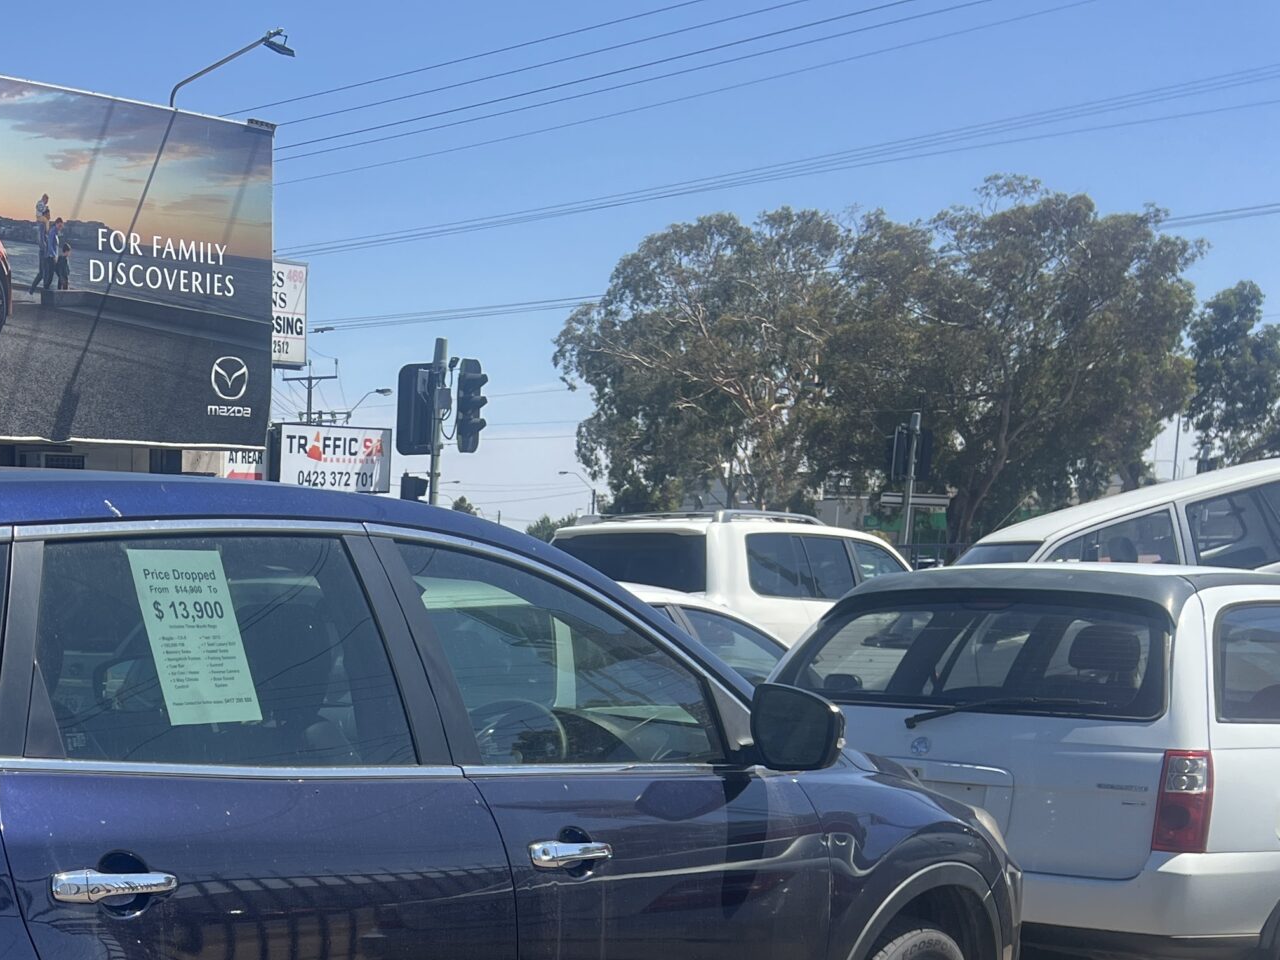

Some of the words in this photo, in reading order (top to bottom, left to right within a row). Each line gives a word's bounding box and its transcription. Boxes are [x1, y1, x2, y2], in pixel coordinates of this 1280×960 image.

[97, 228, 142, 257] FOR
[152, 235, 227, 266] FAMILY
[89, 259, 235, 297] DISCOVERIES
[273, 340, 289, 354] 2512
[286, 432, 359, 462] TRAFFIC
[228, 451, 240, 464] AT
[241, 451, 263, 465] REAR
[298, 470, 326, 487] 0423
[330, 471, 350, 487] 372
[354, 471, 374, 488] 701
[143, 568, 170, 580] Price
[172, 569, 216, 582] Dropped
[149, 585, 169, 593] From
[207, 585, 218, 593] To
[153, 600, 164, 622] $
[169, 601, 224, 622] 13,900
